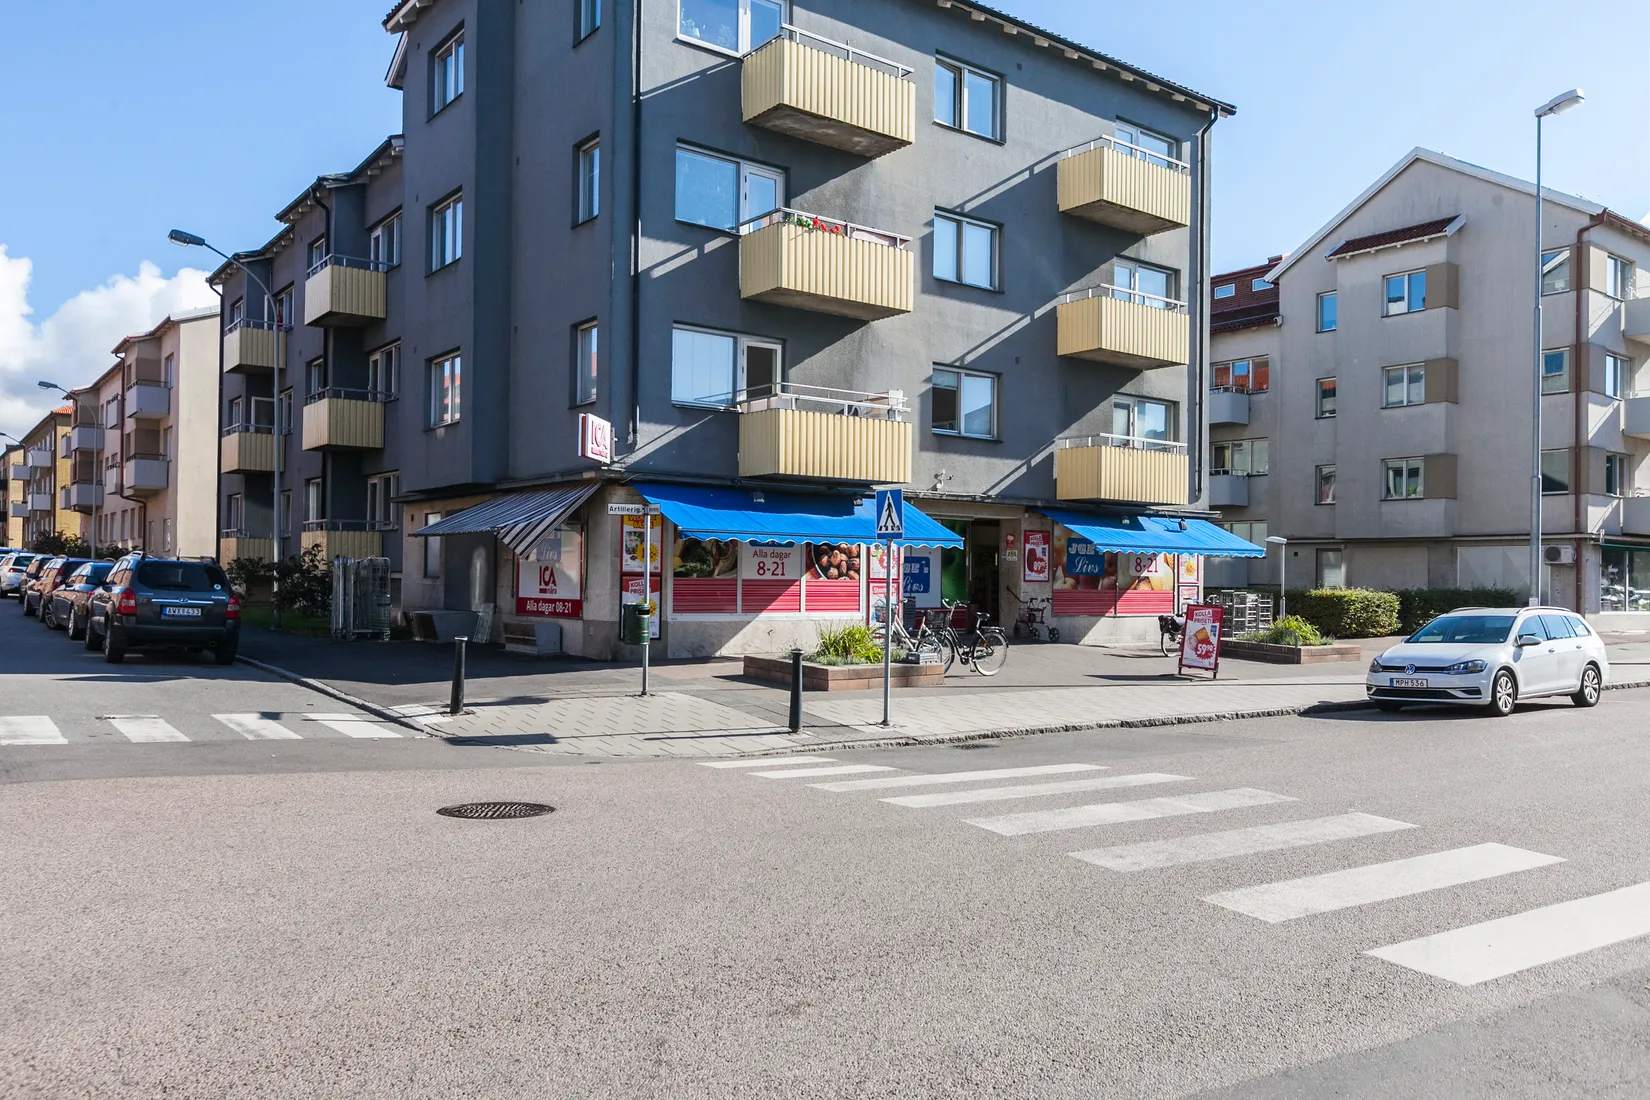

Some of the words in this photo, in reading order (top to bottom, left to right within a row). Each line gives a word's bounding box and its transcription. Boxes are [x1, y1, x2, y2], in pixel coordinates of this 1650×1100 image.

[591, 420, 608, 450] ICA
[752, 550, 768, 559] Alla
[769, 550, 792, 561] dagar
[757, 561, 786, 576] 8-21
[1072, 556, 1099, 574] Livs
[1135, 557, 1158, 573] 8-21
[539, 565, 557, 586] ICA
[526, 600, 538, 611] Alla
[538, 600, 555, 614] dagar
[556, 602, 572, 613] 08-21
